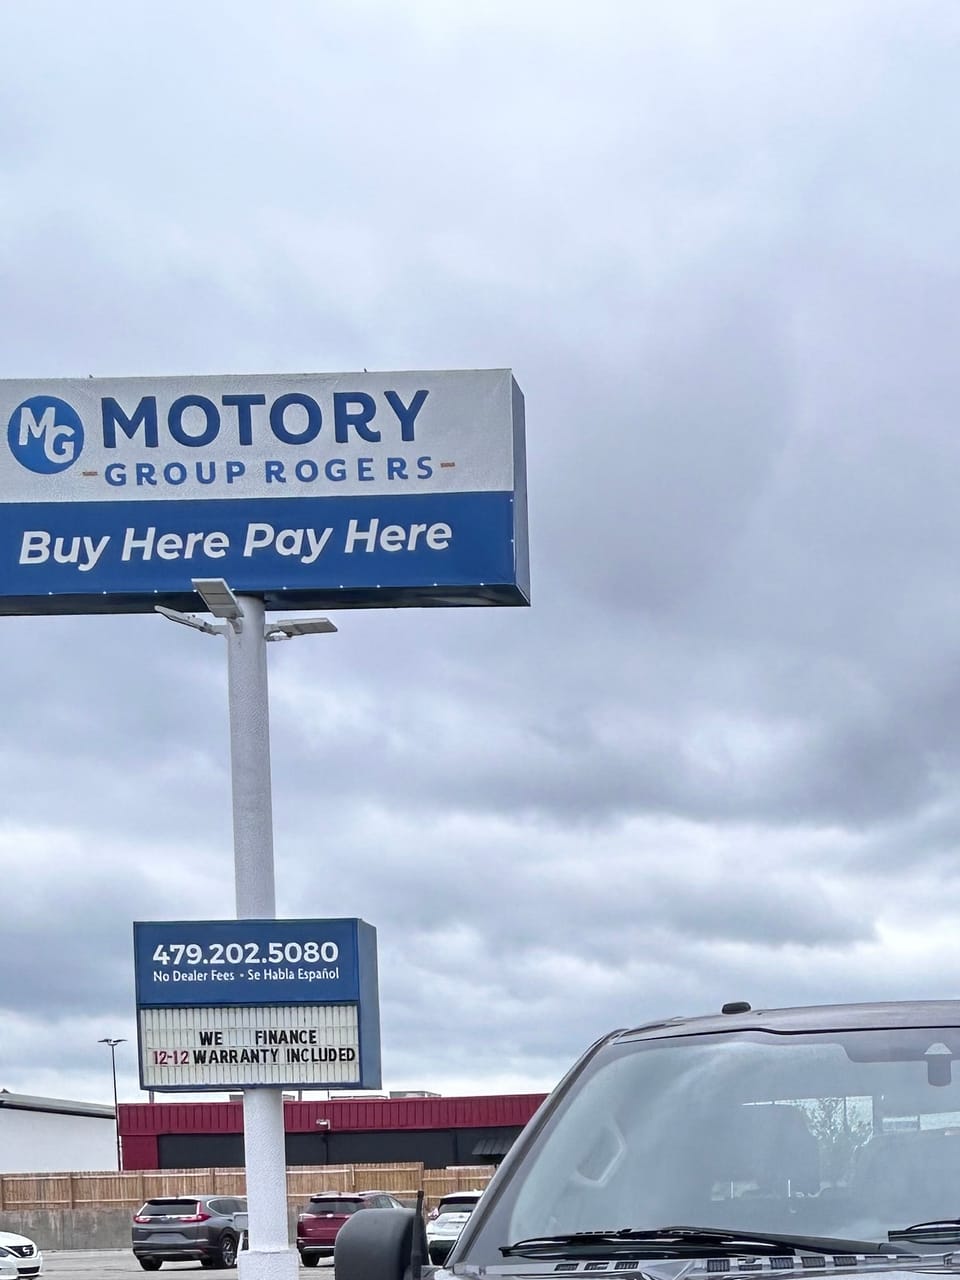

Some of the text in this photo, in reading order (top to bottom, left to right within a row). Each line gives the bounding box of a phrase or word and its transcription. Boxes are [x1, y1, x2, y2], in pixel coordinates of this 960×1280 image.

[100, 389, 430, 449] MOTORY
[19, 406, 76, 463] MG
[104, 455, 434, 486] GROUP ROGERS
[19, 518, 453, 572] Buy Here Pay Here
[152, 941, 339, 966] 479.202.5080
[153, 967, 339, 982] No Dealer Fees Se Habla Español
[199, 1029, 318, 1046] WE FINANCE
[153, 1048, 356, 1065] 12-12 WARRANTY INCLUDED
